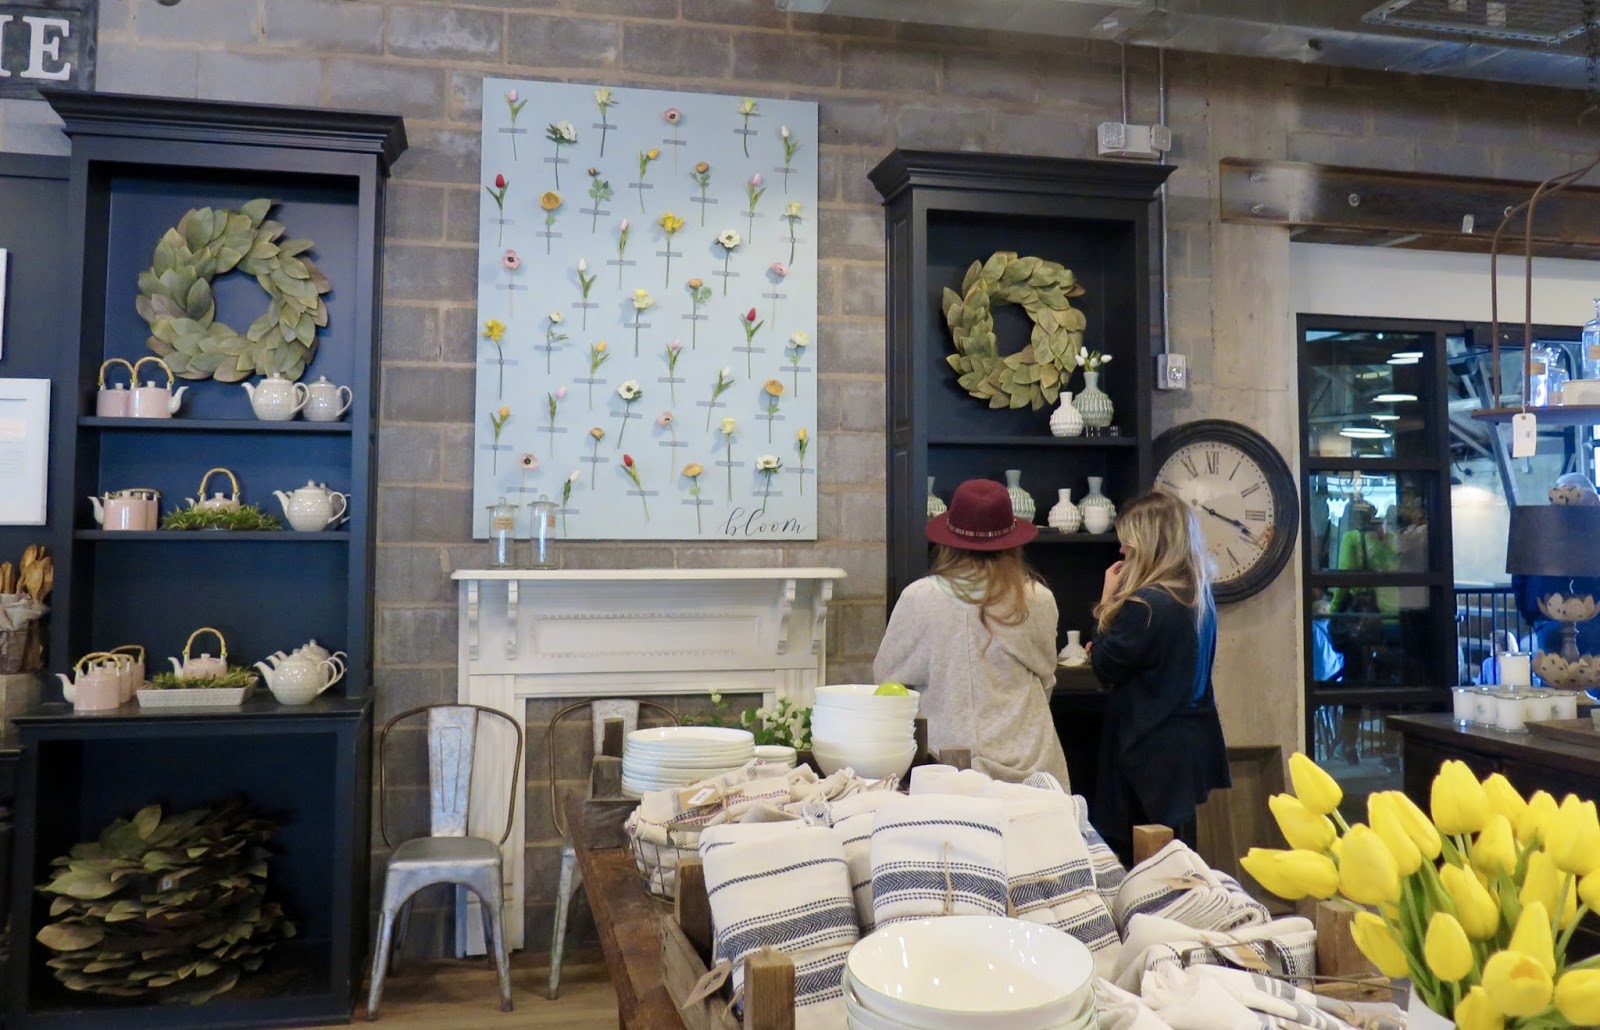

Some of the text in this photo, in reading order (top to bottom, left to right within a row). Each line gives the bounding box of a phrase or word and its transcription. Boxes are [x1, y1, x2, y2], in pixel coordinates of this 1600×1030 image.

[1179, 454, 1199, 481] XI
[1204, 450, 1220, 475] XII
[1240, 482, 1261, 498] II
[720, 506, 806, 537] bloom
[1245, 509, 1266, 521] III
